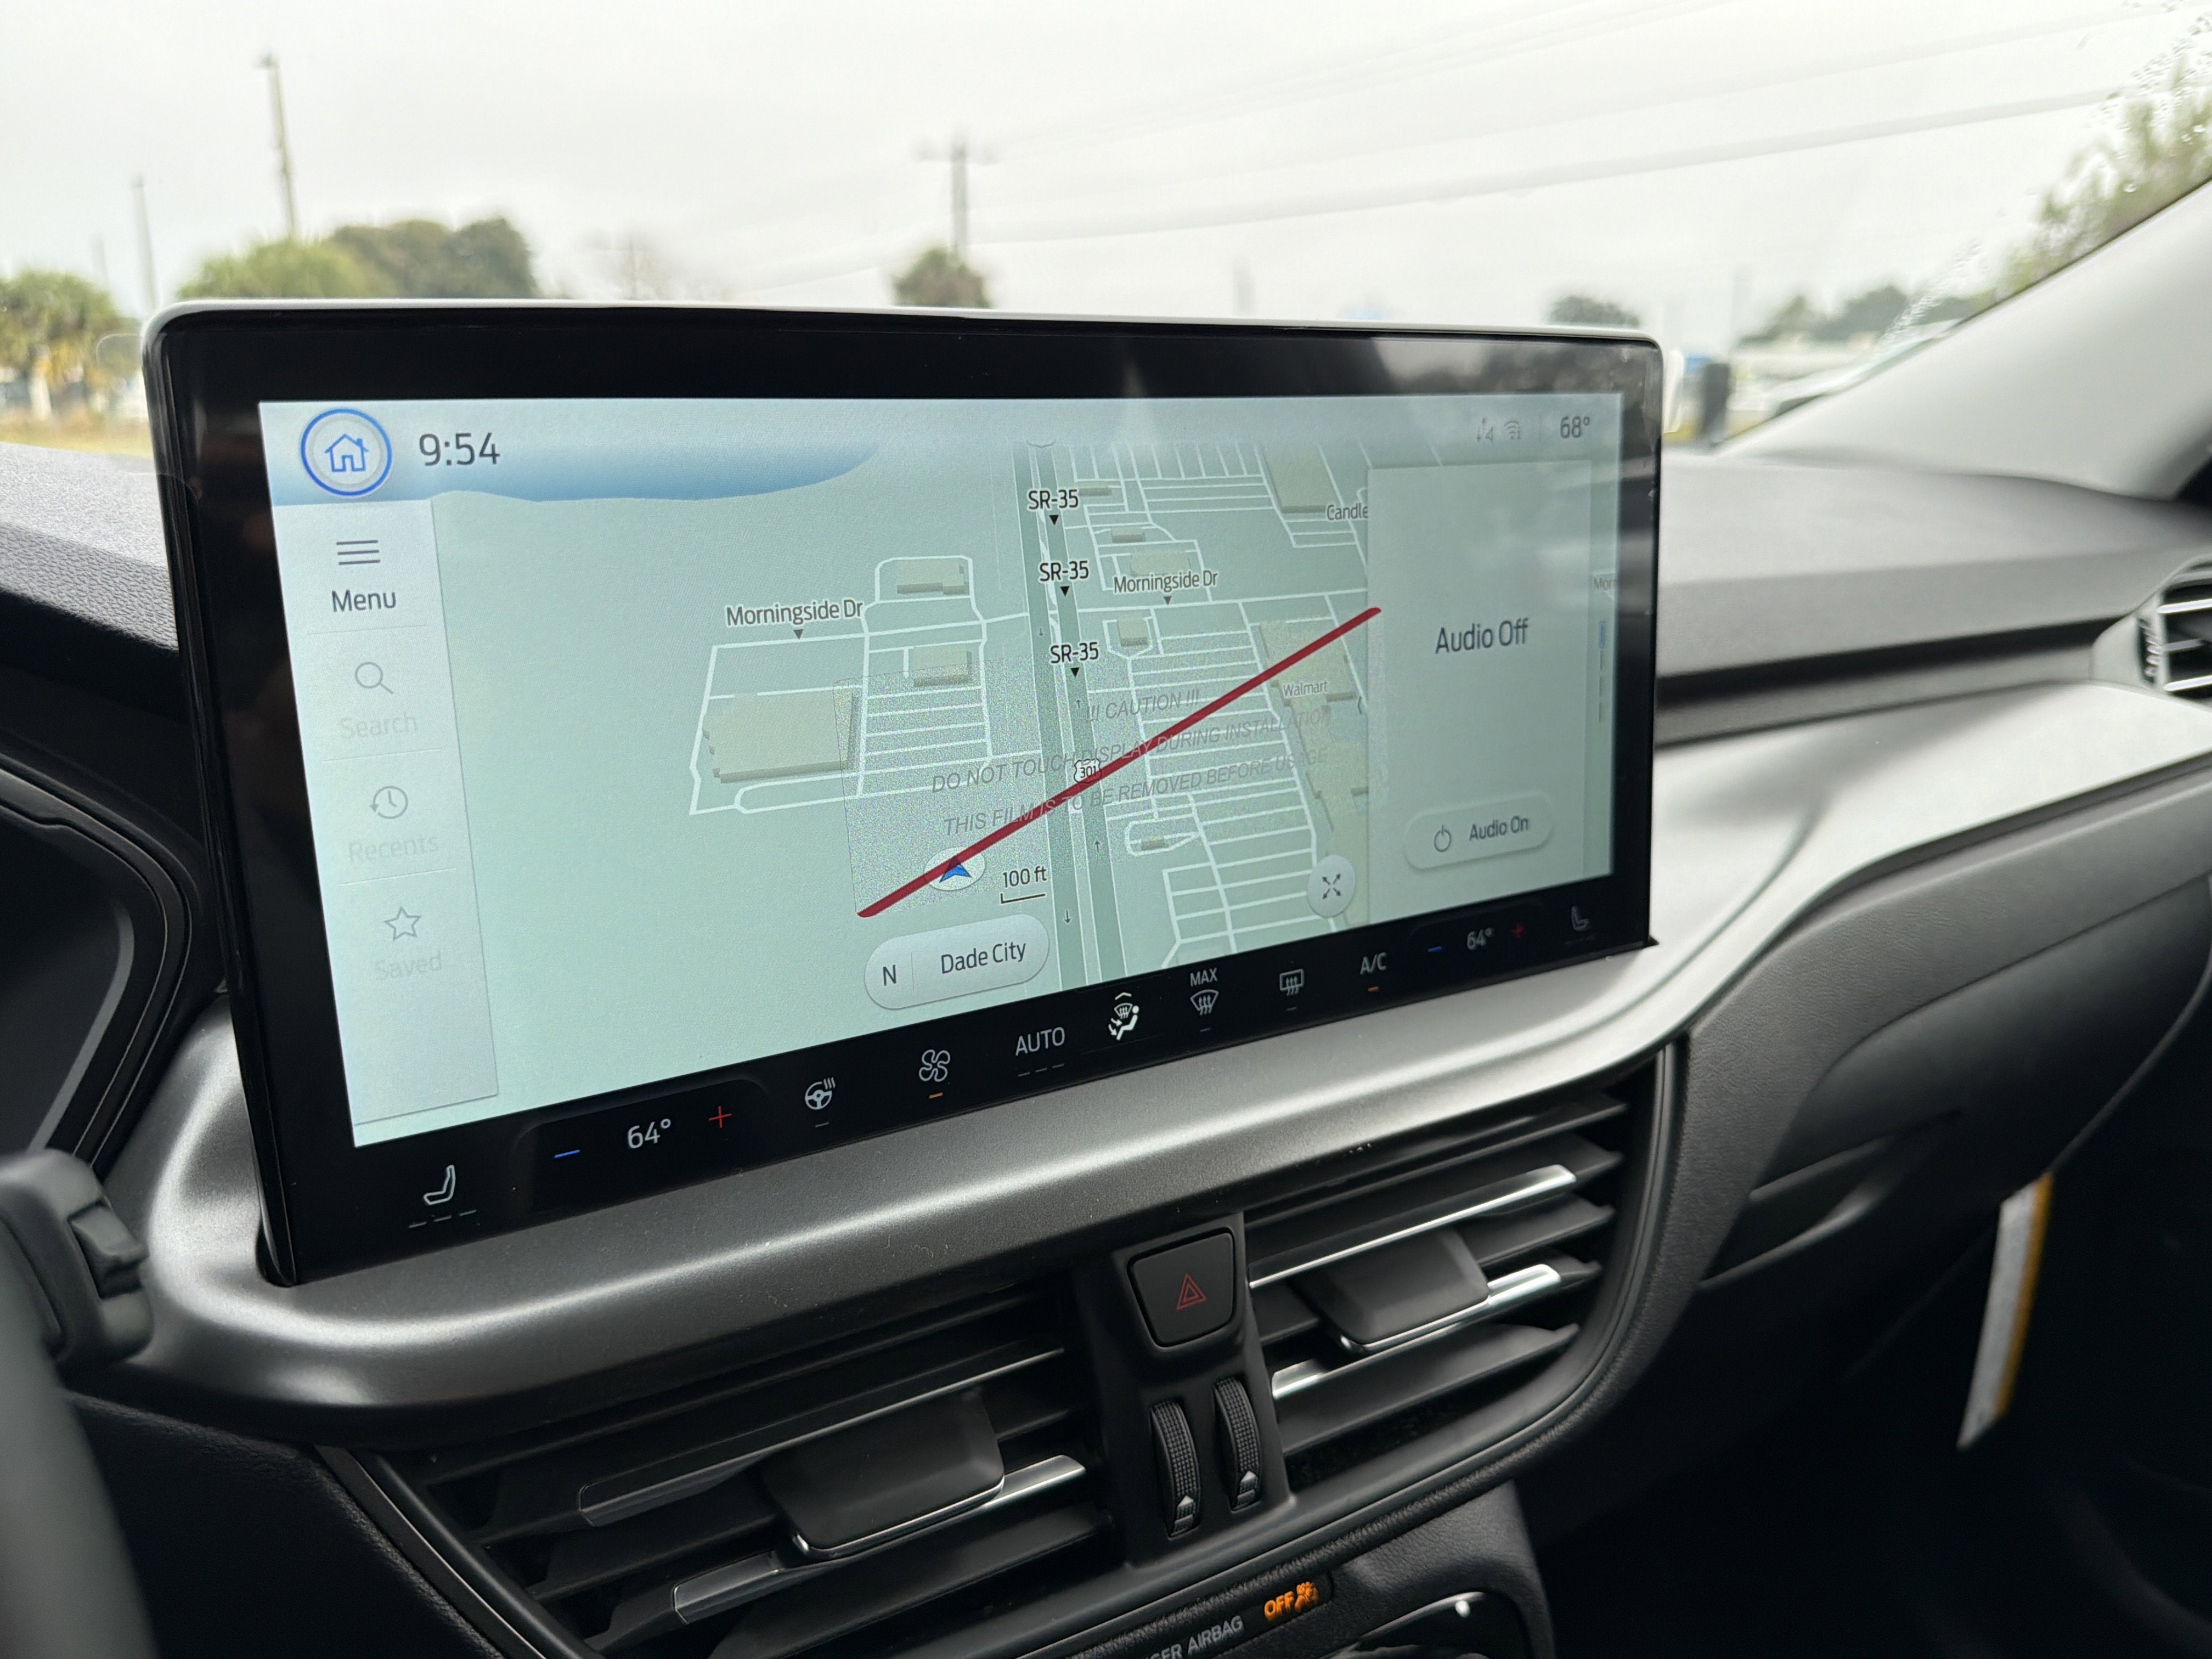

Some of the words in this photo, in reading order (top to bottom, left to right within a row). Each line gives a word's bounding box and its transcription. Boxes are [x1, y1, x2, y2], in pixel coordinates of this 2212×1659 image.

[1560, 416, 1590, 439] 68°
[419, 432, 500, 466] 9:54
[1028, 489, 1079, 510] SR-35
[1326, 504, 1368, 521] Candle
[1039, 561, 1090, 582] SR-35
[1114, 572, 1200, 593] Morningside
[1203, 571, 1218, 586] Dr
[331, 590, 397, 612] Menu
[727, 601, 839, 626] Morningside
[844, 599, 864, 617] Dr
[1435, 625, 1493, 653] Audio
[1499, 618, 1529, 646] Off
[1050, 642, 1099, 664] SR-35
[1283, 680, 1328, 697] Walmart
[1105, 692, 1182, 719] CAUTION
[340, 711, 419, 739] Search
[932, 772, 961, 793] DO
[967, 763, 1007, 787] NOT
[1012, 753, 1076, 779] TOUCH
[1081, 742, 1153, 766] DISPLAY
[1155, 727, 1221, 753] DURING
[1080, 765, 1097, 778] 301
[944, 812, 986, 836] THIS
[992, 803, 1035, 827] FILM
[1040, 799, 1056, 816] IS
[1062, 796, 1083, 813] TO
[1090, 788, 1114, 807] BE
[1118, 772, 1201, 802] REMOVED
[1207, 759, 1271, 785] BEFORE
[1469, 820, 1508, 842] Audio
[1510, 815, 1530, 833] On
[348, 836, 439, 864] Recents
[1003, 869, 1030, 888] 100
[1034, 865, 1047, 883] ft
[375, 950, 443, 980] Saved
[882, 965, 897, 986] N
[941, 947, 988, 974] Dade
[992, 941, 1026, 964] City
[1190, 967, 1218, 986] MAX
[1360, 952, 1387, 975] A/C
[1015, 1027, 1065, 1056] AUTO
[627, 1118, 672, 1149] 64°
[1264, 1591, 1294, 1621] OFF
[1188, 1616, 1244, 1655] AIRBAG
